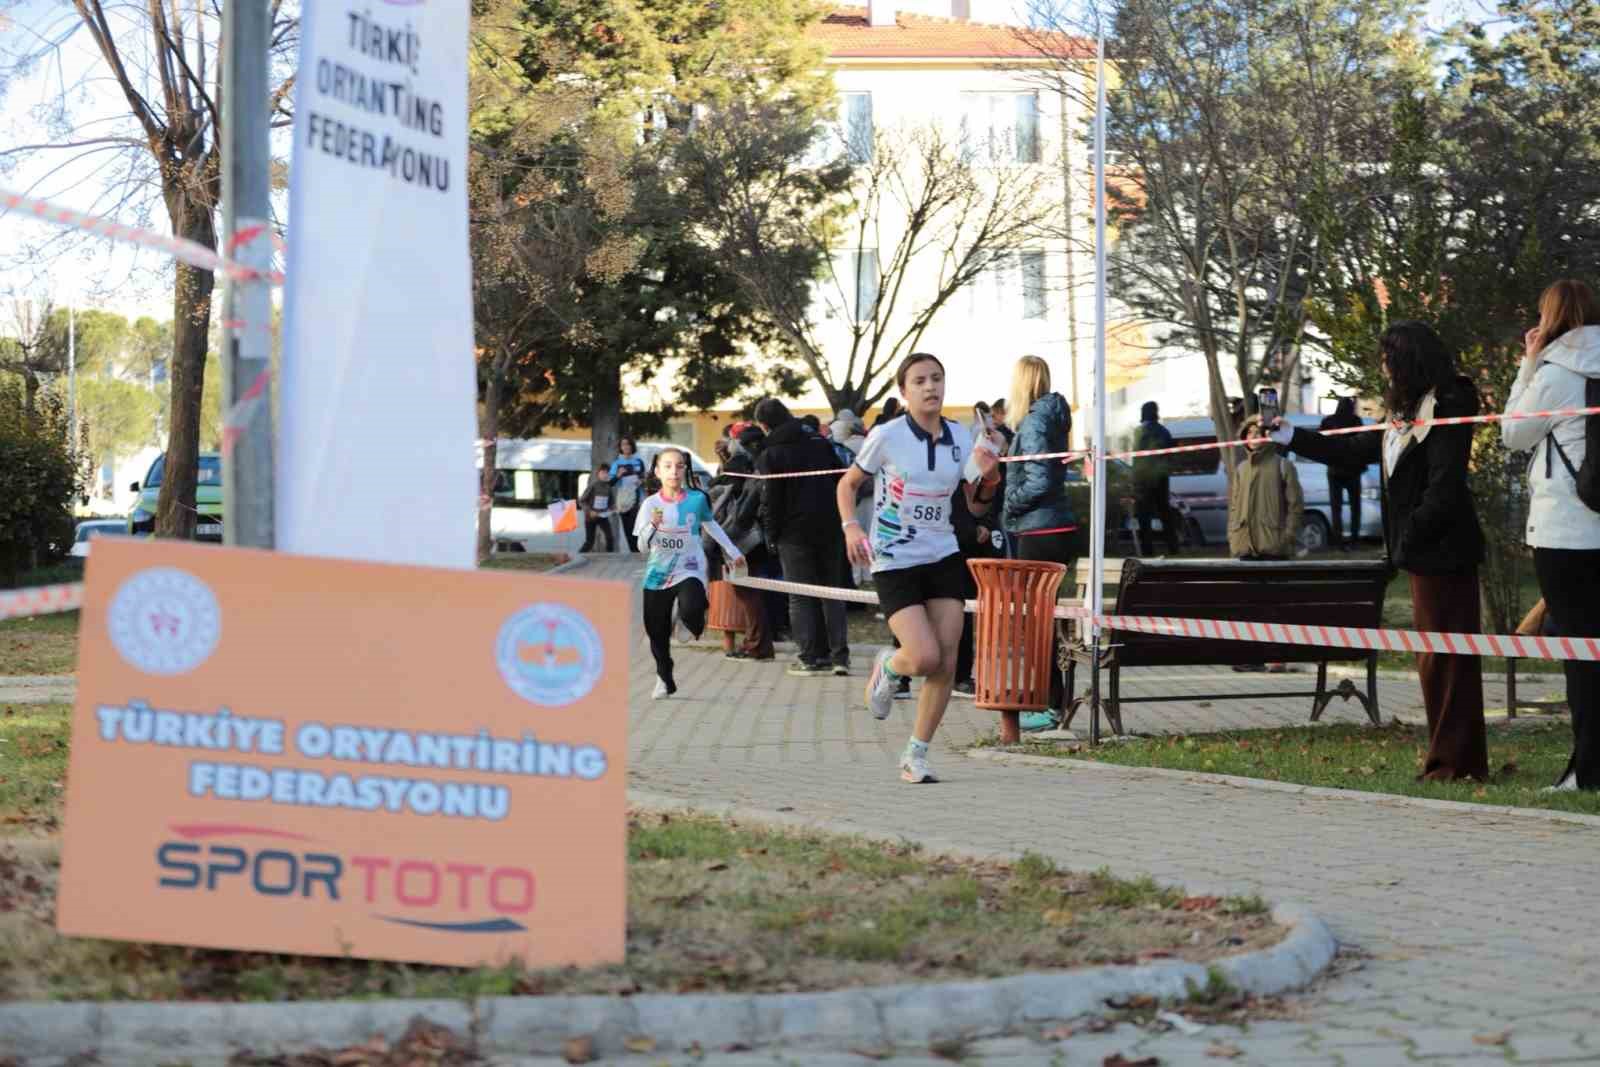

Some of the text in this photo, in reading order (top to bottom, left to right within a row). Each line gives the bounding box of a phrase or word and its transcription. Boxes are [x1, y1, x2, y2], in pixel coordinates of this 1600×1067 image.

[913, 505, 942, 521] 588
[661, 538, 684, 549] 500
[97, 702, 607, 780] TÜRKİYE ORYANTİRİNG
[189, 762, 511, 820] FEDERASYONU
